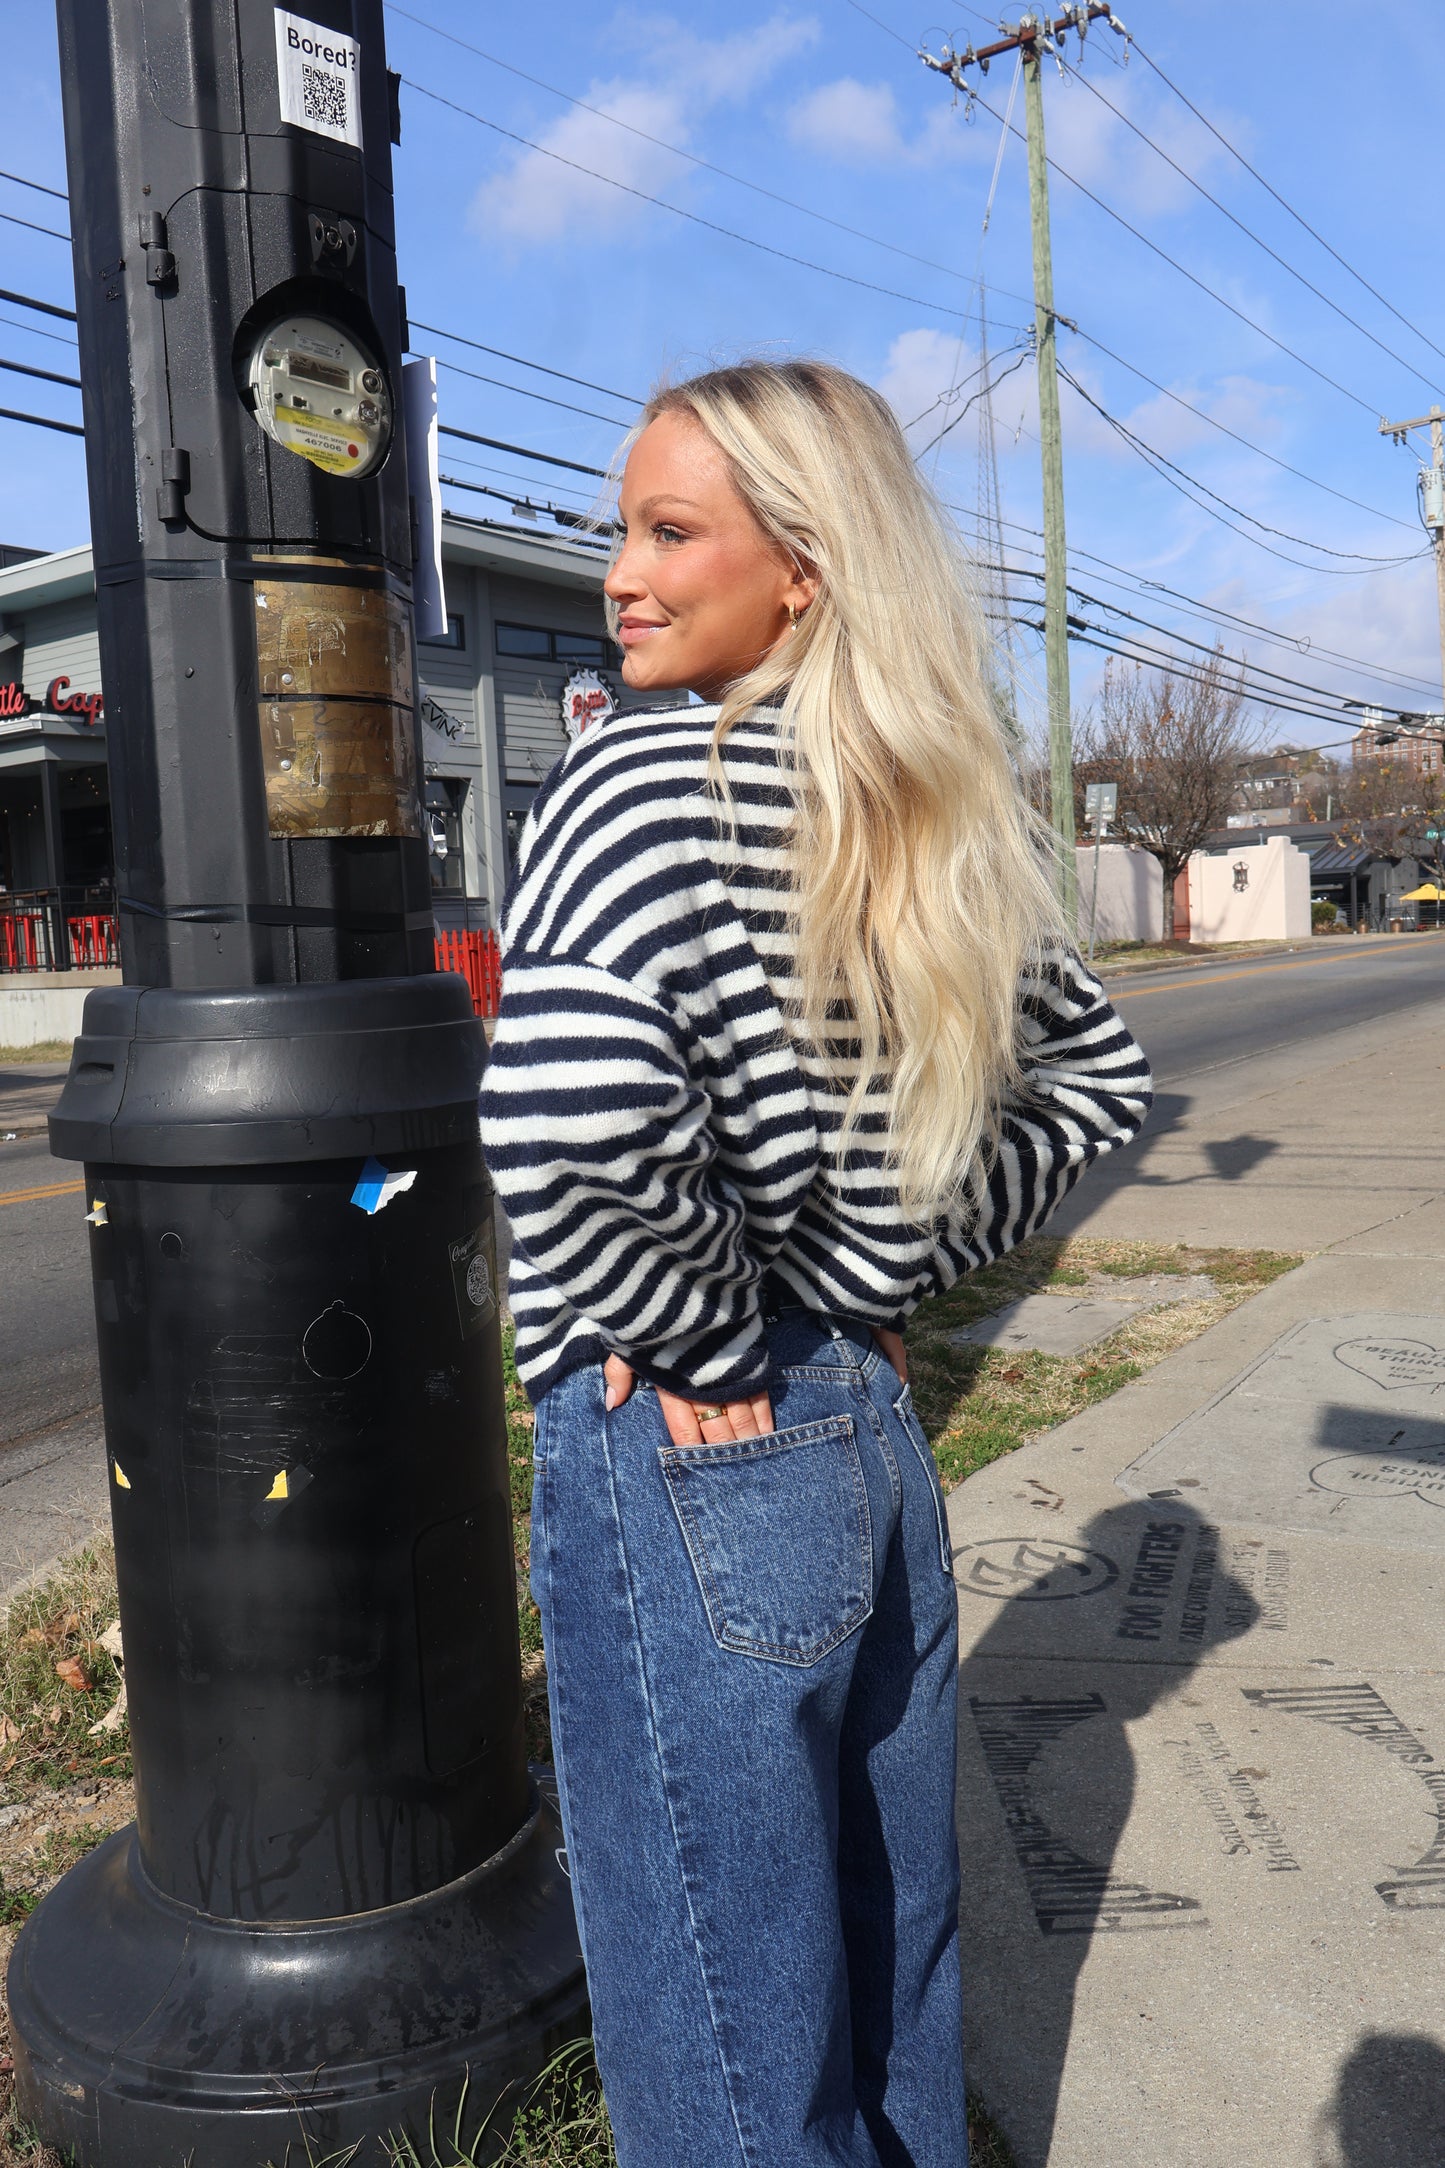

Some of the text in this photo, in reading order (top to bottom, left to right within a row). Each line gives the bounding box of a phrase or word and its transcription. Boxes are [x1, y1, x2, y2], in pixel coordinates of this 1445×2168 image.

[287, 26, 357, 72] Bored?
[304, 437, 342, 452] 467006
[1116, 1521, 1186, 1642] FOO FIGHTERS
[1191, 1550, 1217, 1575] TOUR
[1264, 1549, 1291, 1590] STADIUM
[1184, 1577, 1213, 1612] COVER
[1226, 1564, 1256, 1601] AUGUST
[1178, 1612, 1207, 1644] TAKE
[1195, 1722, 1302, 1872] Bridgestone Arena
[1200, 1787, 1251, 1856] Saturday
